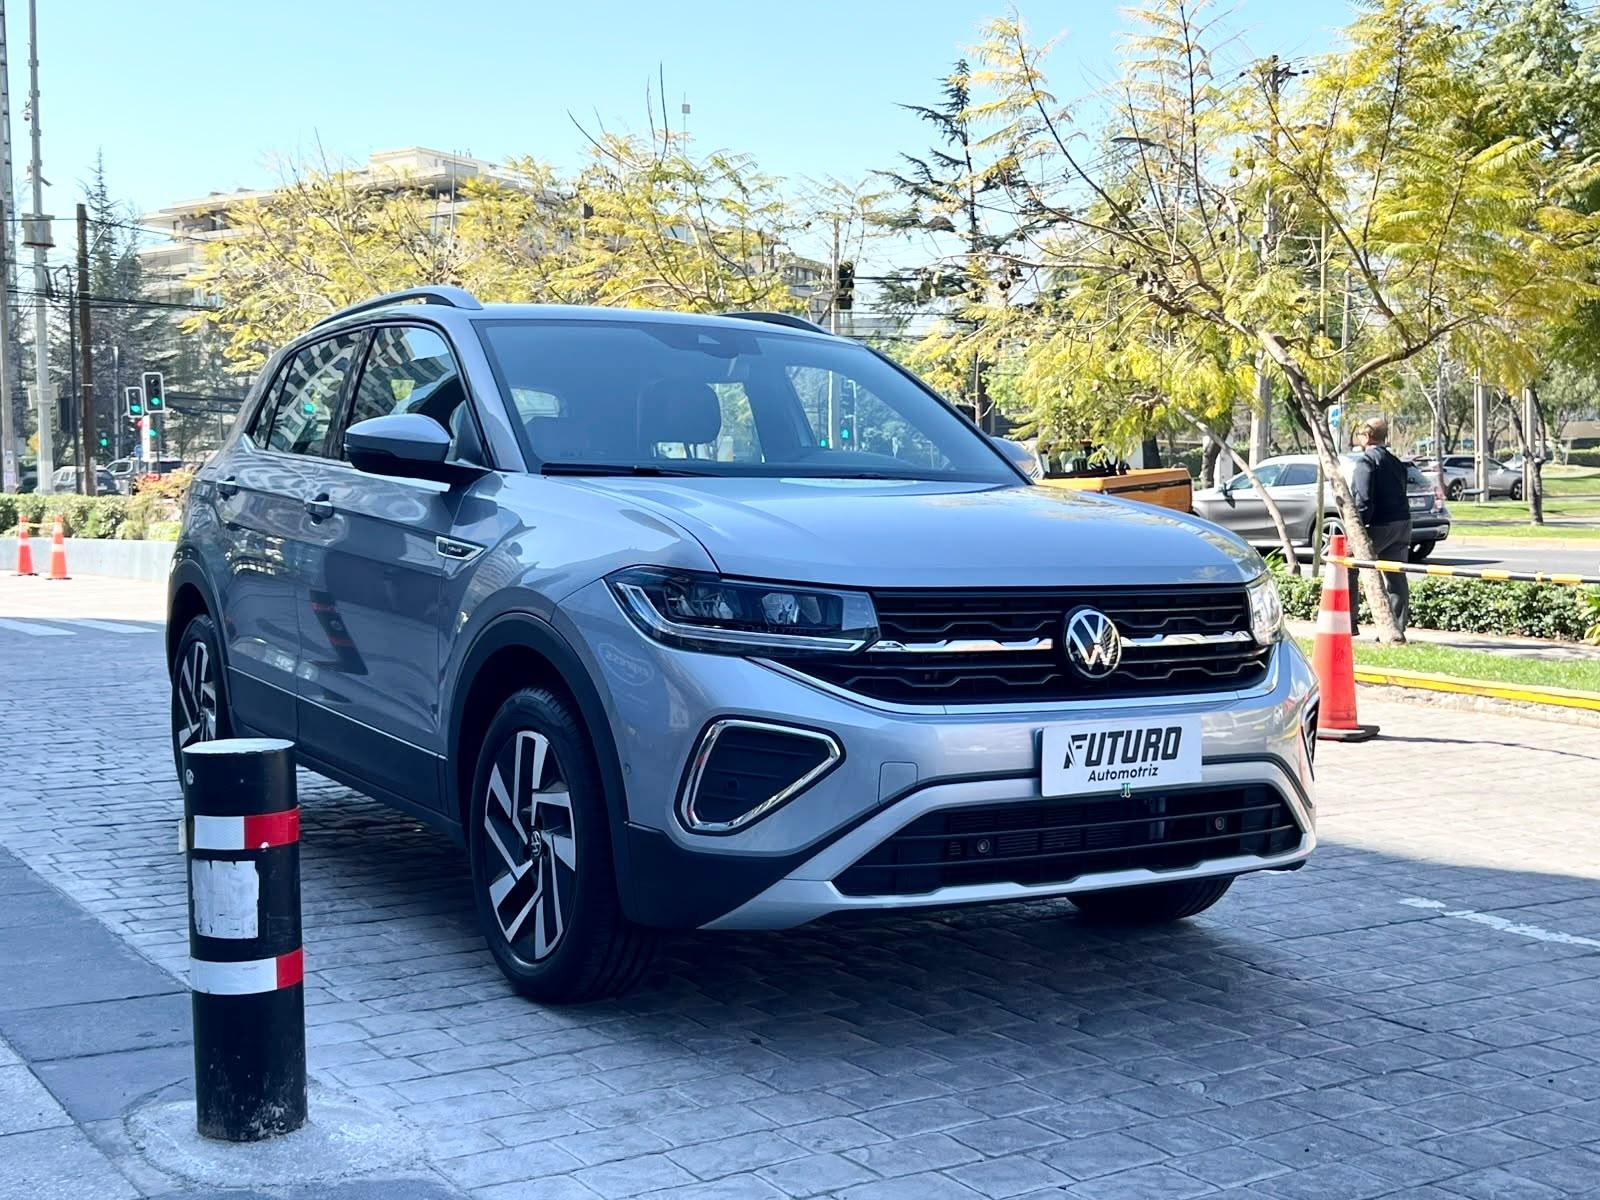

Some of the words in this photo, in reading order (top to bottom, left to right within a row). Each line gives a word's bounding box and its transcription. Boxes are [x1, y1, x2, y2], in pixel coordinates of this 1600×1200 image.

[1067, 609, 1120, 678] VW
[1063, 726, 1182, 769] FUTURO
[1088, 764, 1159, 782] Automotriz
